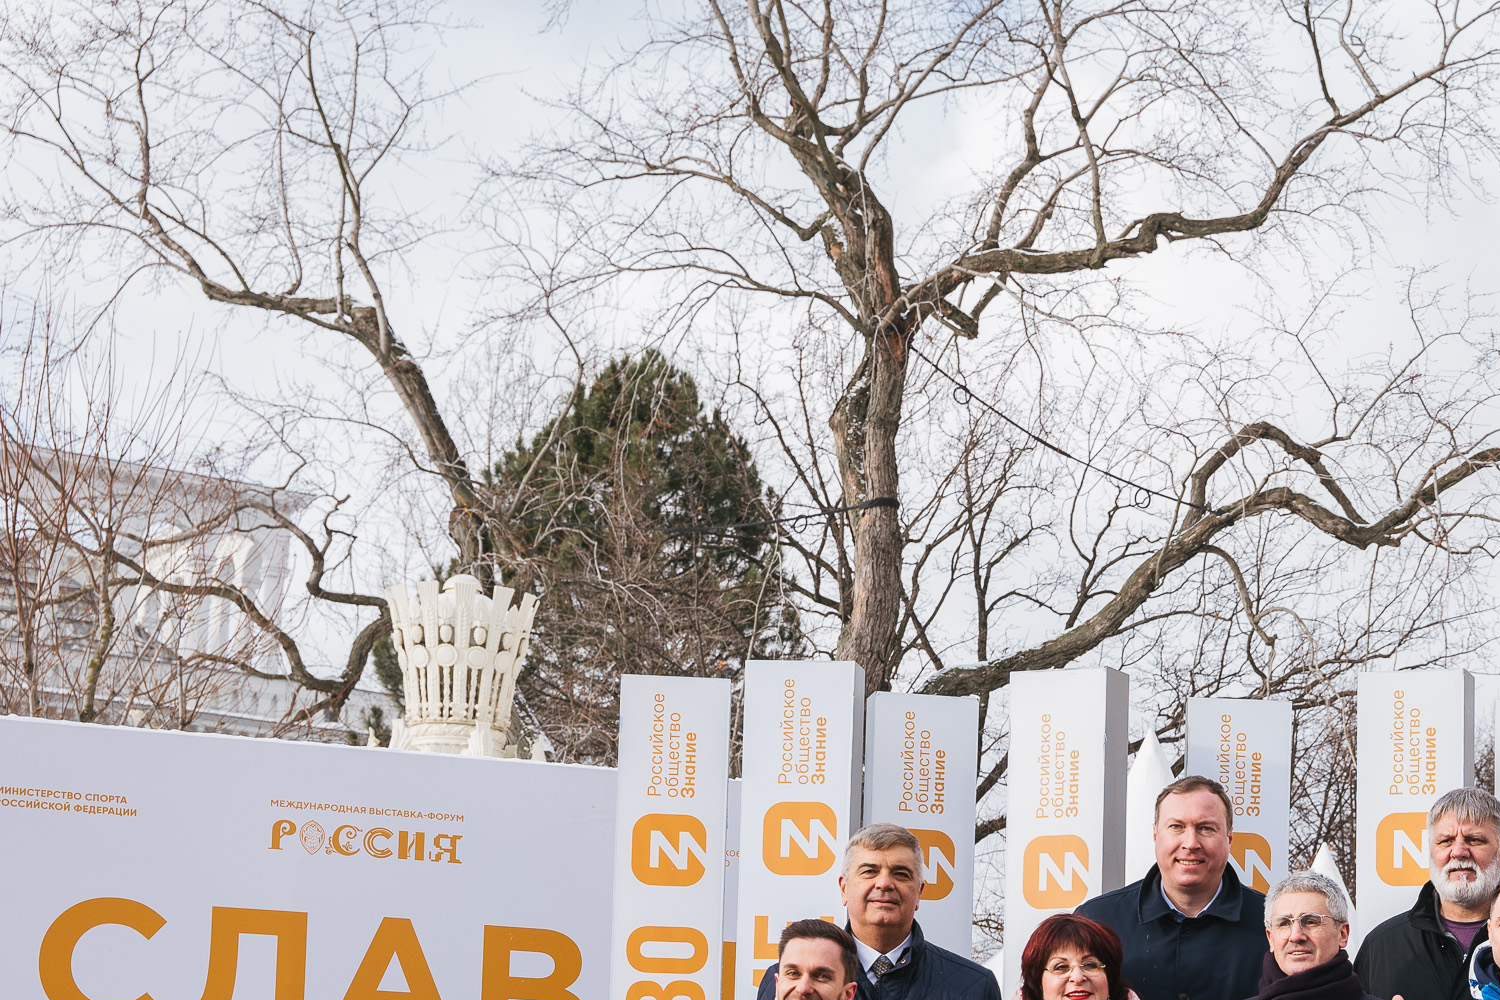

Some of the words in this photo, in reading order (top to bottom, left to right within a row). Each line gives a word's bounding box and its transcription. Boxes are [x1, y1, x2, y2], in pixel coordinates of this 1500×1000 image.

[646, 693, 665, 797] Российское
[664, 712, 682, 798] общество
[679, 731, 697, 799] Знание
[777, 678, 796, 785] Российское
[794, 697, 812, 785] общество
[810, 716, 828, 785] Знание
[898, 711, 916, 813] Российское
[914, 729, 932, 814] общество
[1035, 713, 1052, 819] Российское
[1230, 731, 1249, 817] общество
[1388, 689, 1405, 796] Российское
[1405, 707, 1423, 796] общество
[1421, 727, 1437, 795] Знание
[0, 798, 71, 812] ОССИЙСКОЙ
[73, 803, 137, 817] ФЕДЕРАЦИИ
[84, 792, 128, 804] СПОРТА
[270, 799, 367, 814] МЕЖДУНАРОДНАЯ
[368, 807, 465, 823] ВЫСТАВКА-ФОРУМ
[929, 749, 946, 815] Знание
[1050, 731, 1066, 819] общество
[1065, 749, 1080, 818] Знание
[1245, 751, 1263, 818] Знание
